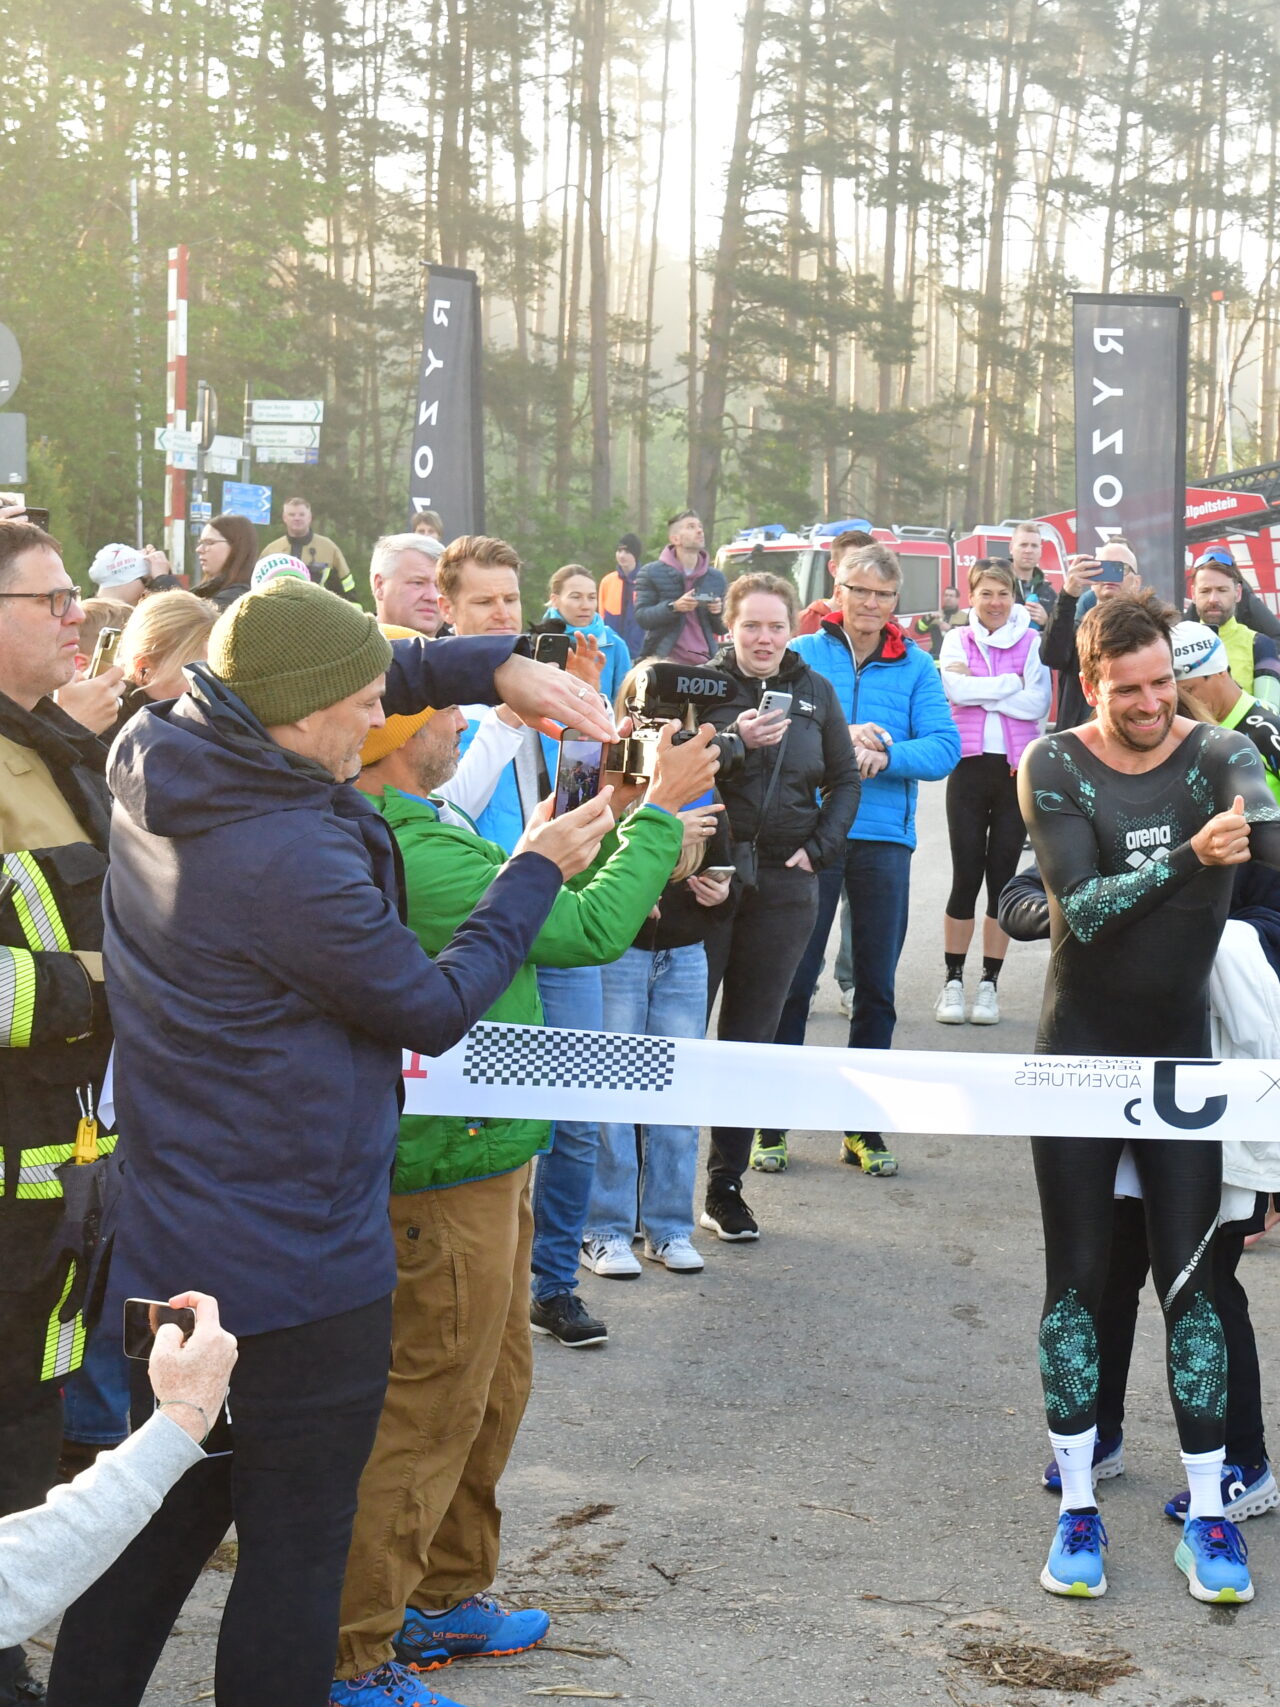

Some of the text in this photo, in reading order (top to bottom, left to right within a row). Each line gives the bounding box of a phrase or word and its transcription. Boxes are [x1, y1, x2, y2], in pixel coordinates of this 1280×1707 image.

[1184, 496, 1238, 520] ilpoltstein
[677, 676, 727, 697] RØDE
[1126, 825, 1171, 850] arena
